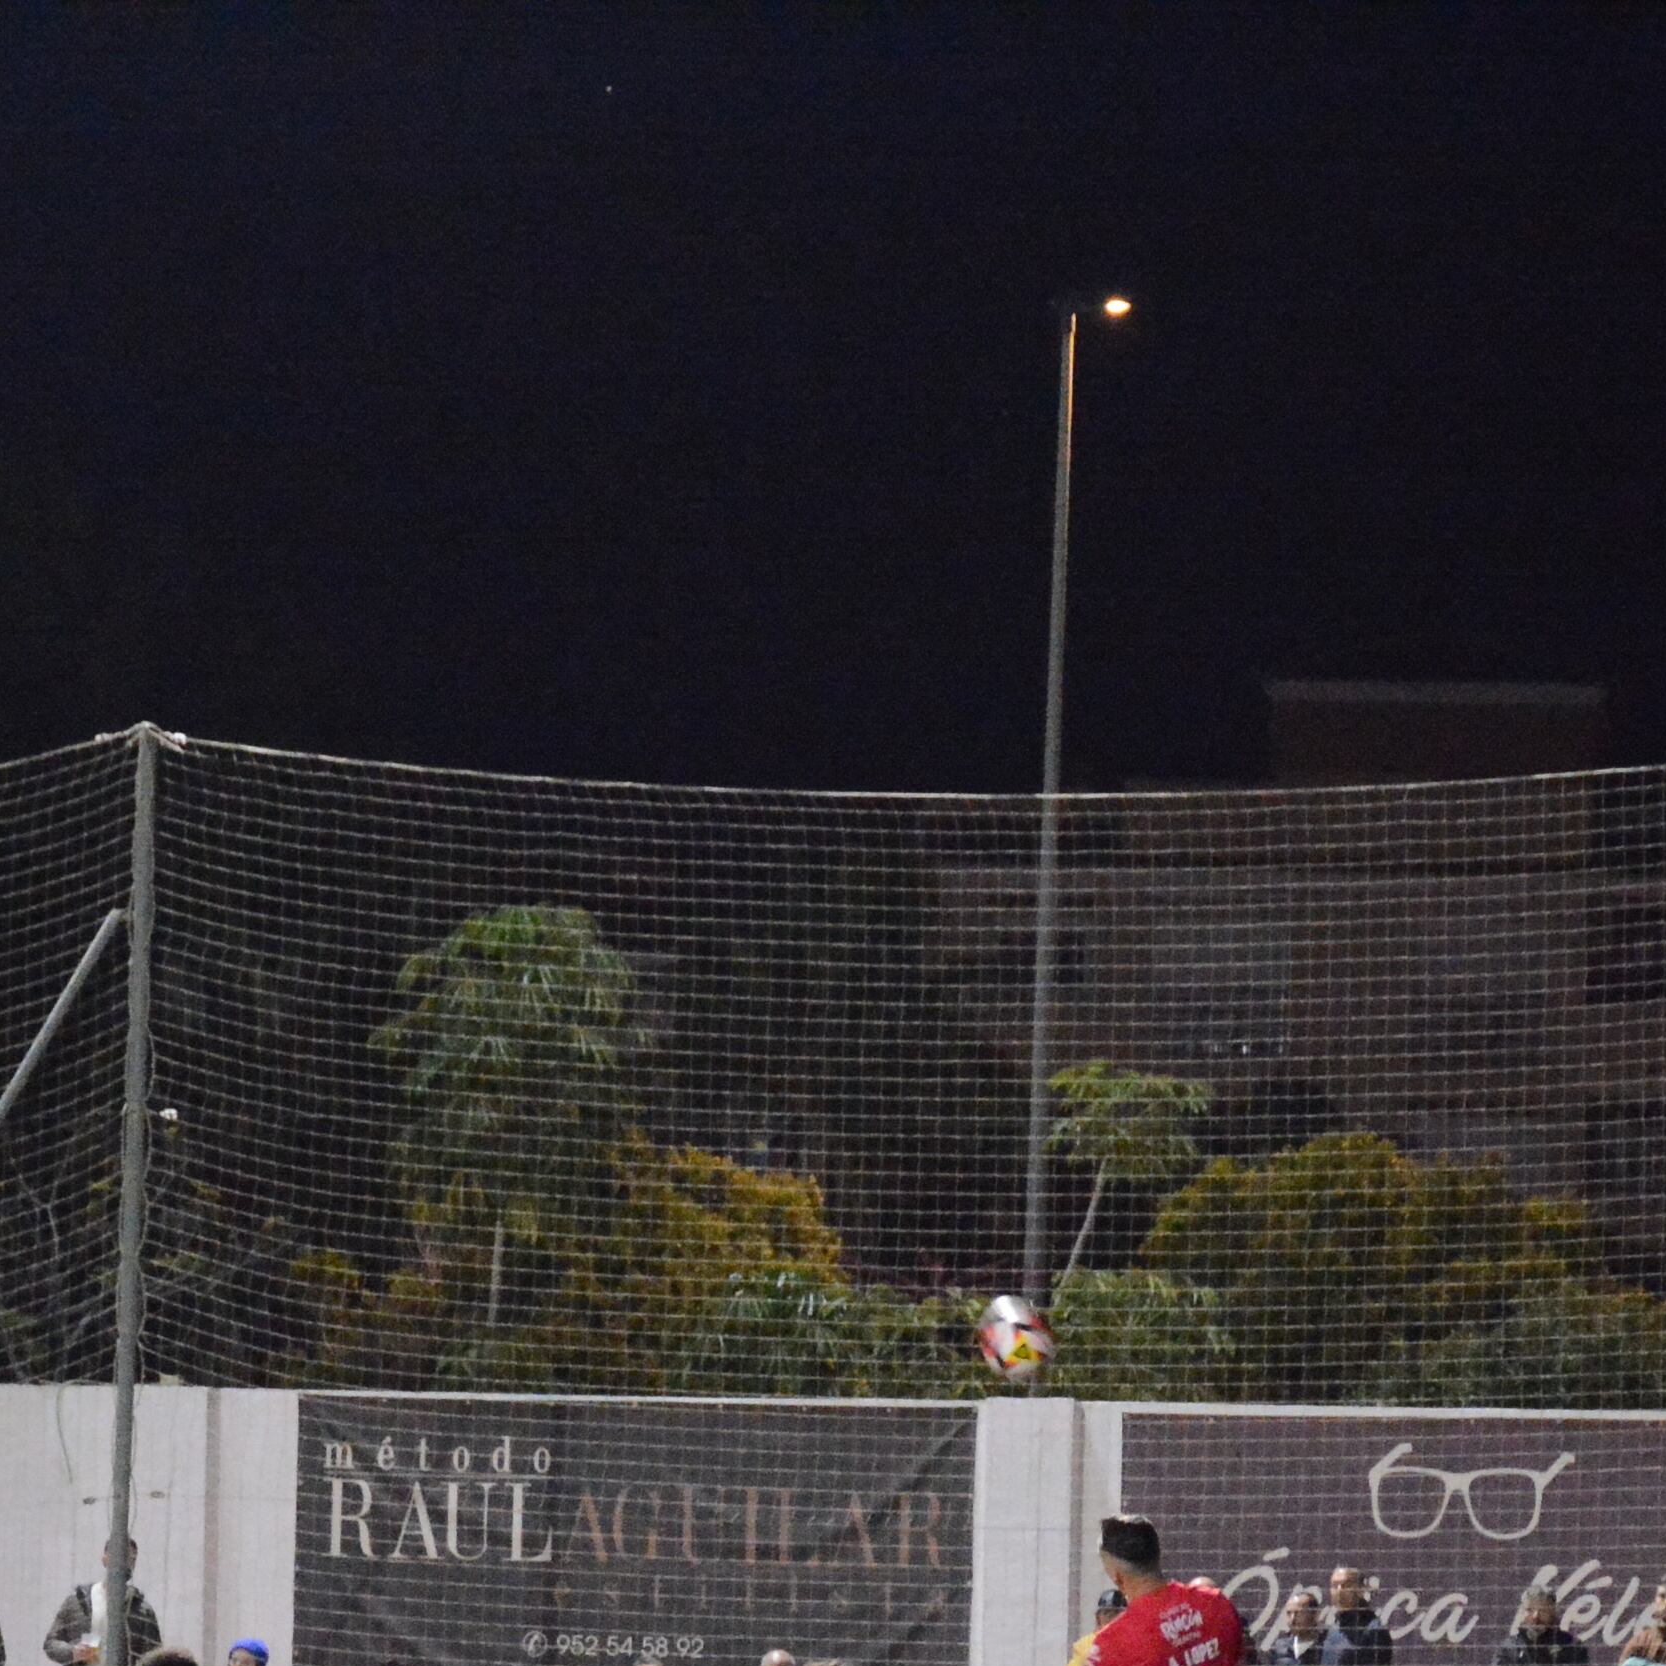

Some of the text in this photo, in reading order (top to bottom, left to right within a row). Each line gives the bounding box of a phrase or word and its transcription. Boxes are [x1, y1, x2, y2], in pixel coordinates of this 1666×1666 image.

[322, 1435, 553, 1473] método
[327, 1476, 945, 1570] RAUL AGUILAR
[555, 1633, 705, 1660] 952 54 58 92
